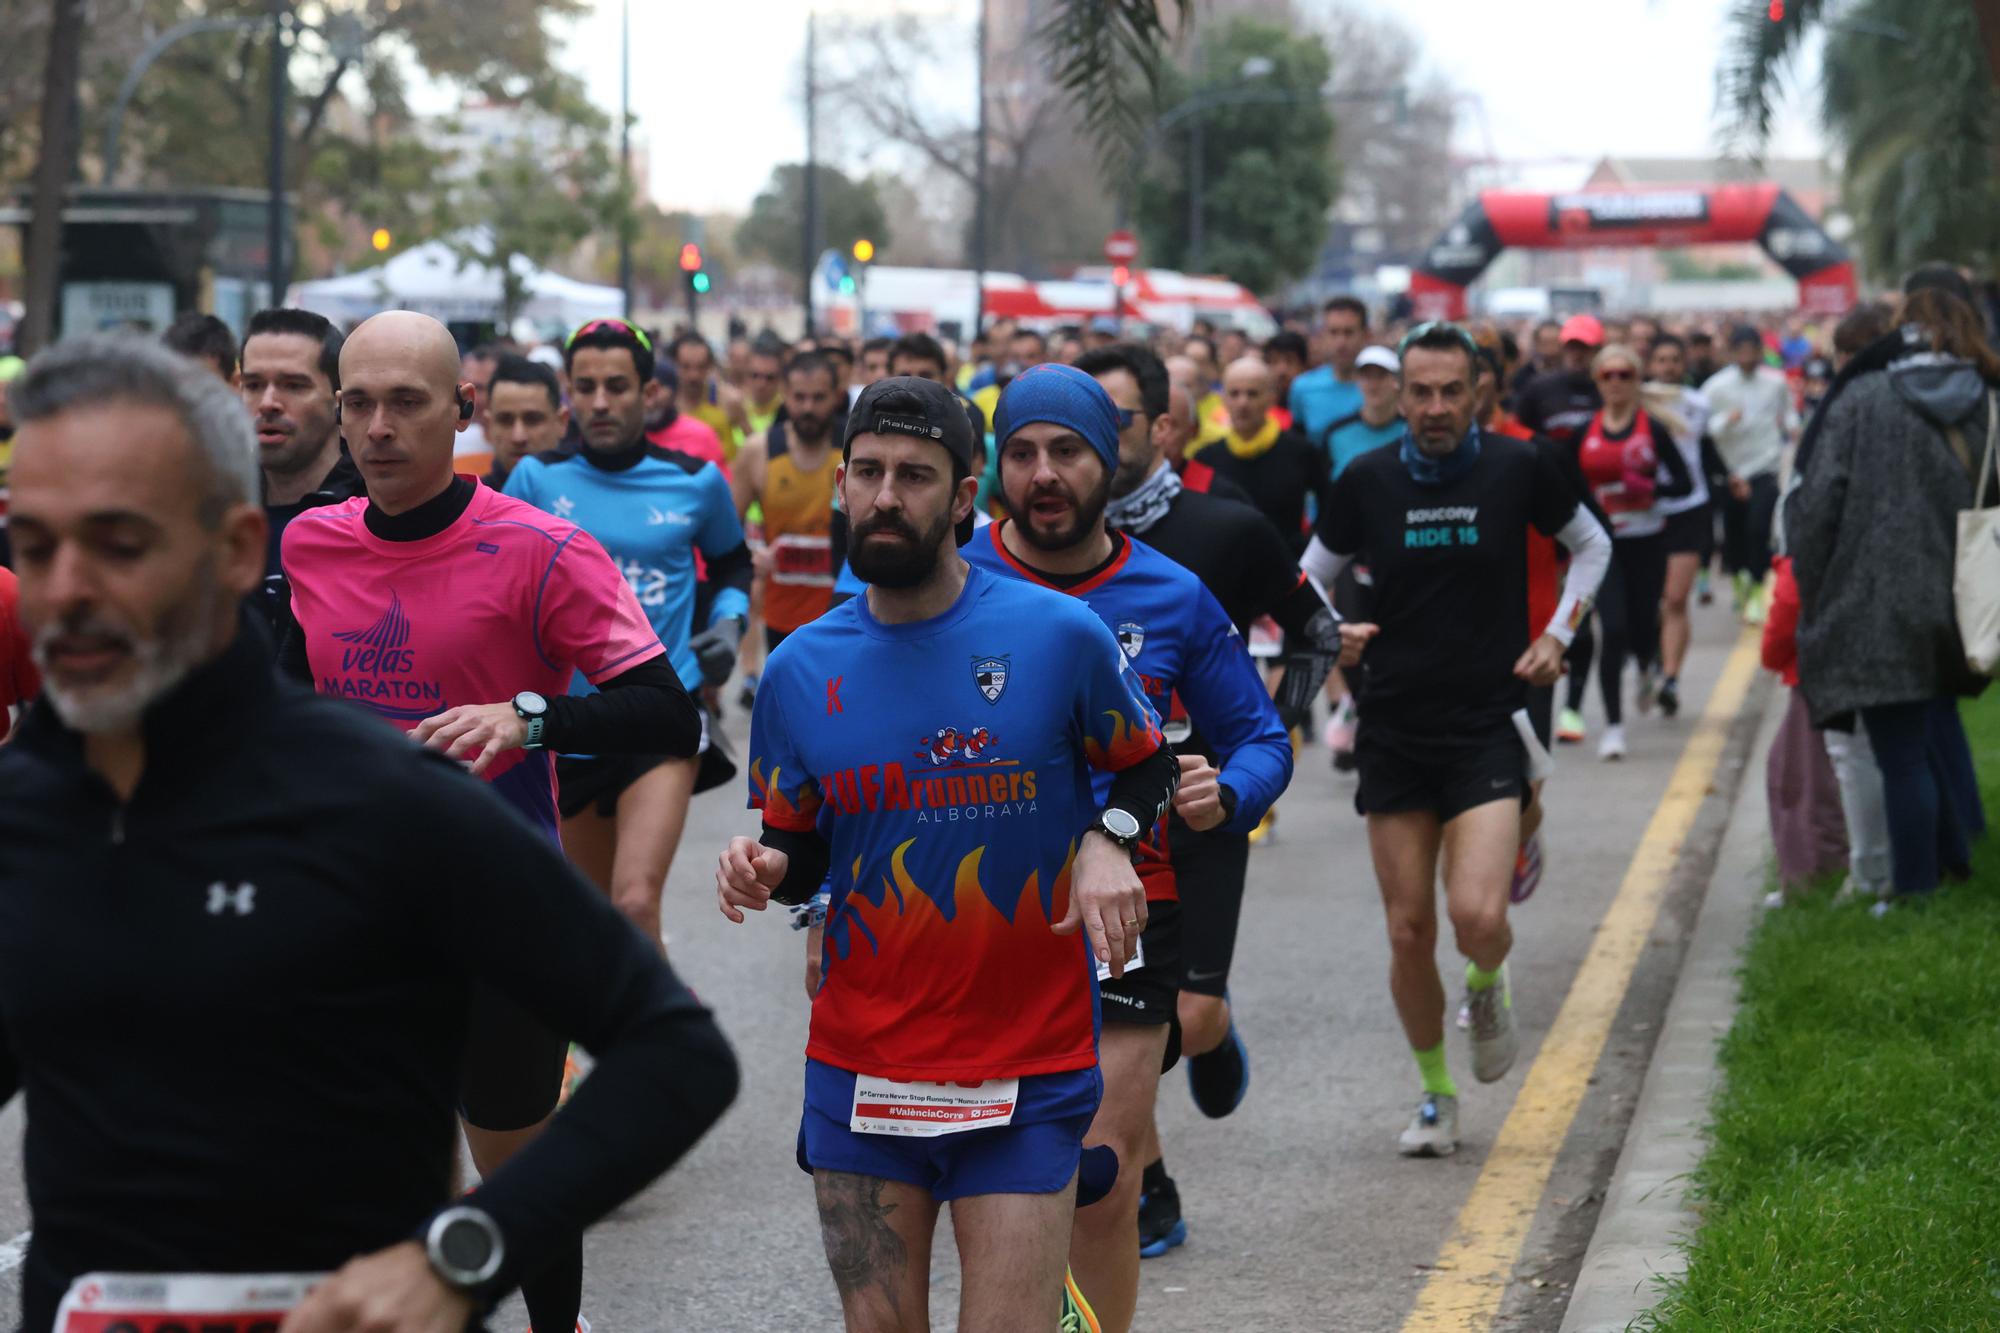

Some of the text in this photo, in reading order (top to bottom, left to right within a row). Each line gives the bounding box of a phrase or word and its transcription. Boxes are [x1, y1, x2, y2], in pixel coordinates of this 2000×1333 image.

[882, 418, 928, 435] Kalenji
[1406, 506, 1478, 524] saucony
[1405, 526, 1479, 548] RIDE 15
[342, 646, 415, 678] velas
[323, 677, 441, 700] MARATON
[827, 674, 843, 717] K
[917, 800, 1037, 824] ALBORAYA
[1100, 991, 1134, 1006] uanvi
[867, 1091, 889, 1099] Carrera
[909, 1094, 925, 1102] Stop
[926, 1095, 953, 1104] Running
